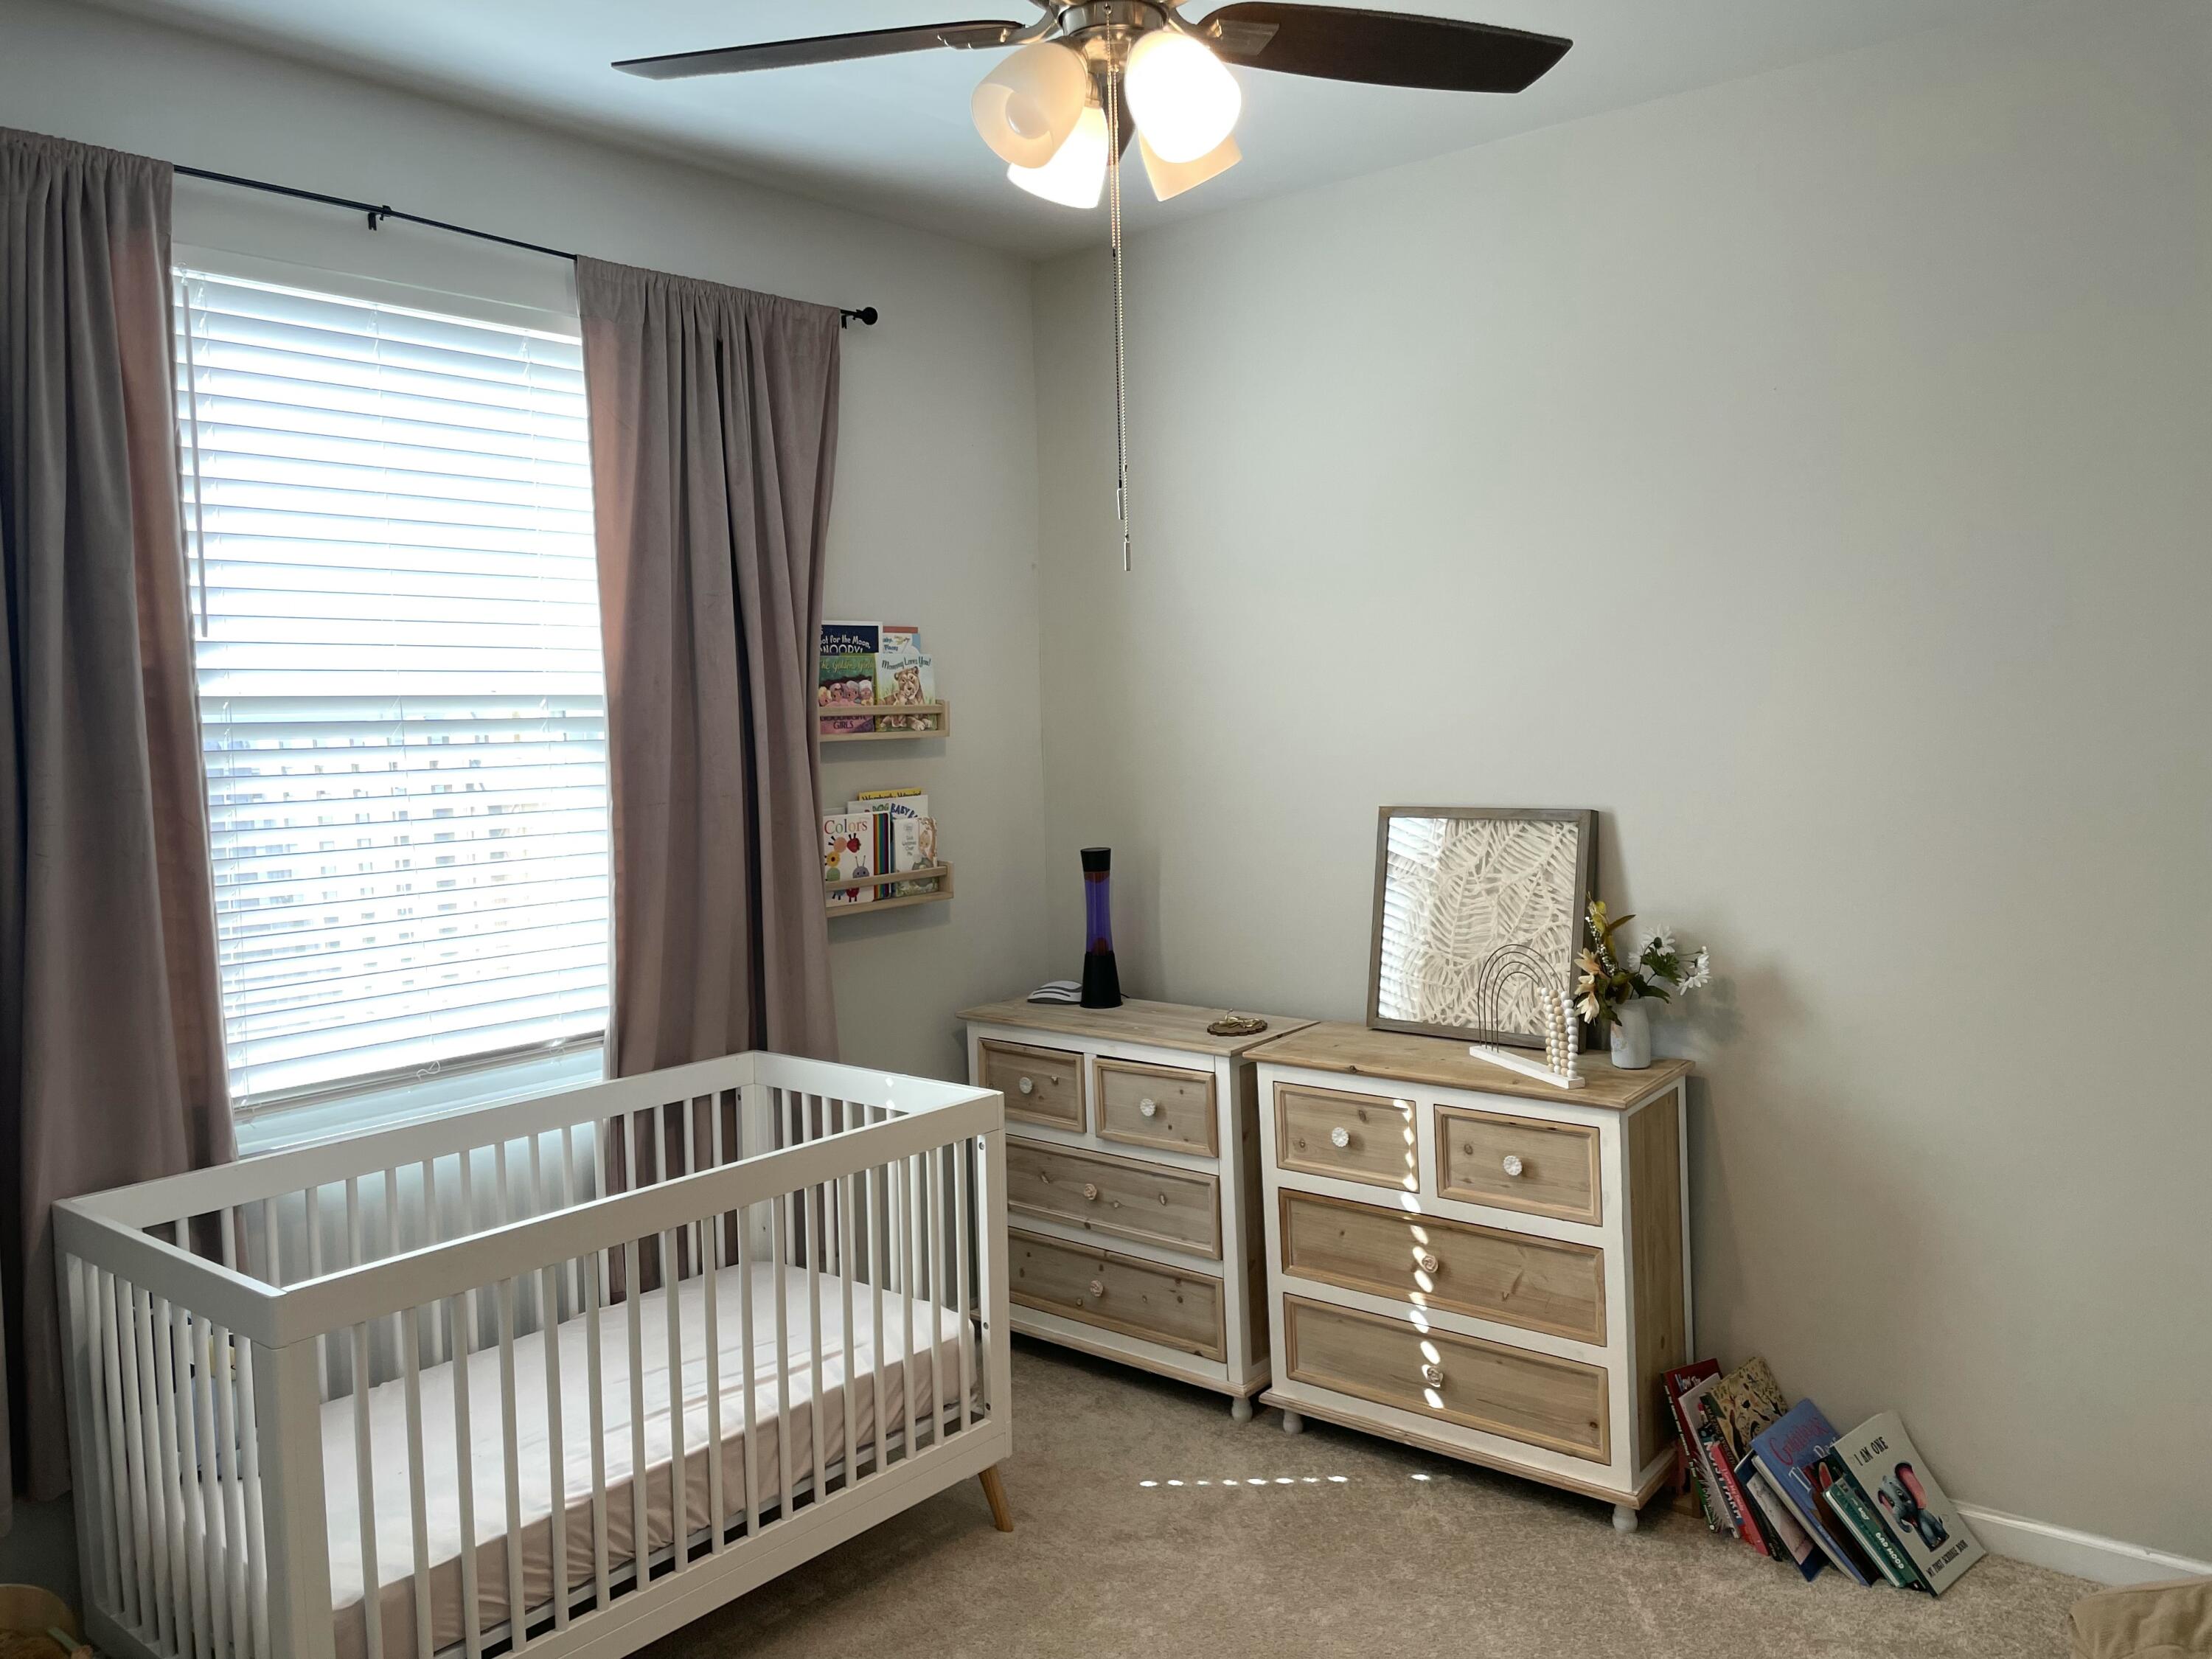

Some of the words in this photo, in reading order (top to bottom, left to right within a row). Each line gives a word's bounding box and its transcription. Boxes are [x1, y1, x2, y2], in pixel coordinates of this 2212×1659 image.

[830, 635, 841, 643] for
[842, 634, 851, 643] the
[852, 636, 871, 649] Moon,
[882, 660, 905, 669] Mommy
[904, 656, 918, 665] Loves
[918, 656, 931, 667] You!
[833, 721, 854, 729] GIRLS
[891, 803, 910, 815] BABY
[824, 818, 867, 834] Colors
[1854, 1454, 1863, 1466] I
[1860, 1447, 1873, 1463] AM
[1871, 1436, 1888, 1455] ONE
[1875, 1531, 1888, 1548] BAD
[1886, 1547, 1905, 1569] MOOD
